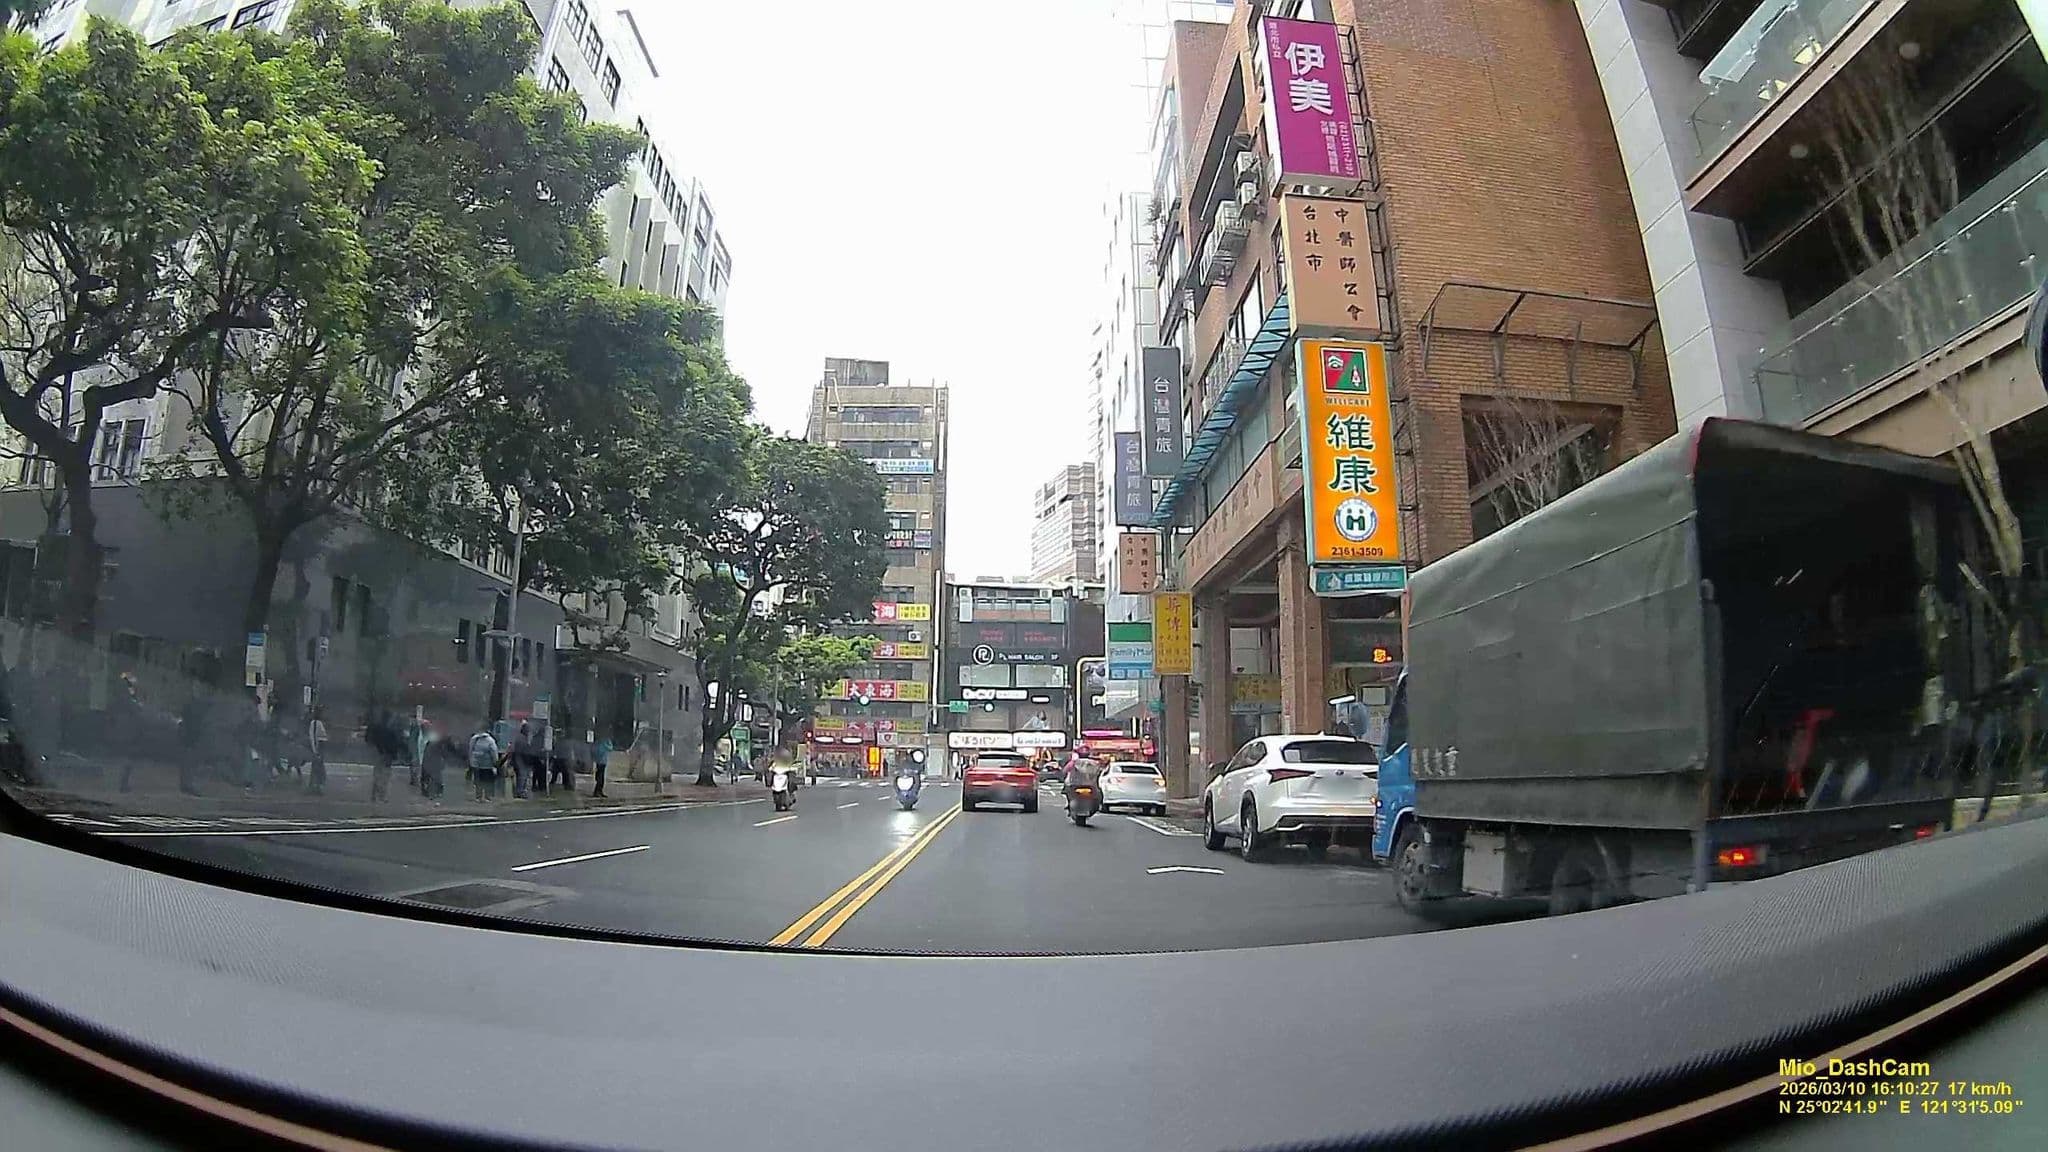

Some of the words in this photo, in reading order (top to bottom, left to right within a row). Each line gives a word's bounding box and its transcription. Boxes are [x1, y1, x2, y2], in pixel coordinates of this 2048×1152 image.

[1285, 43, 1334, 115] 伊美
[1303, 205, 1323, 271] 台北市
[1335, 208, 1363, 320] 中醫師公會
[1327, 412, 1378, 495] 維康
[1331, 547, 1383, 556] 2361-3509
